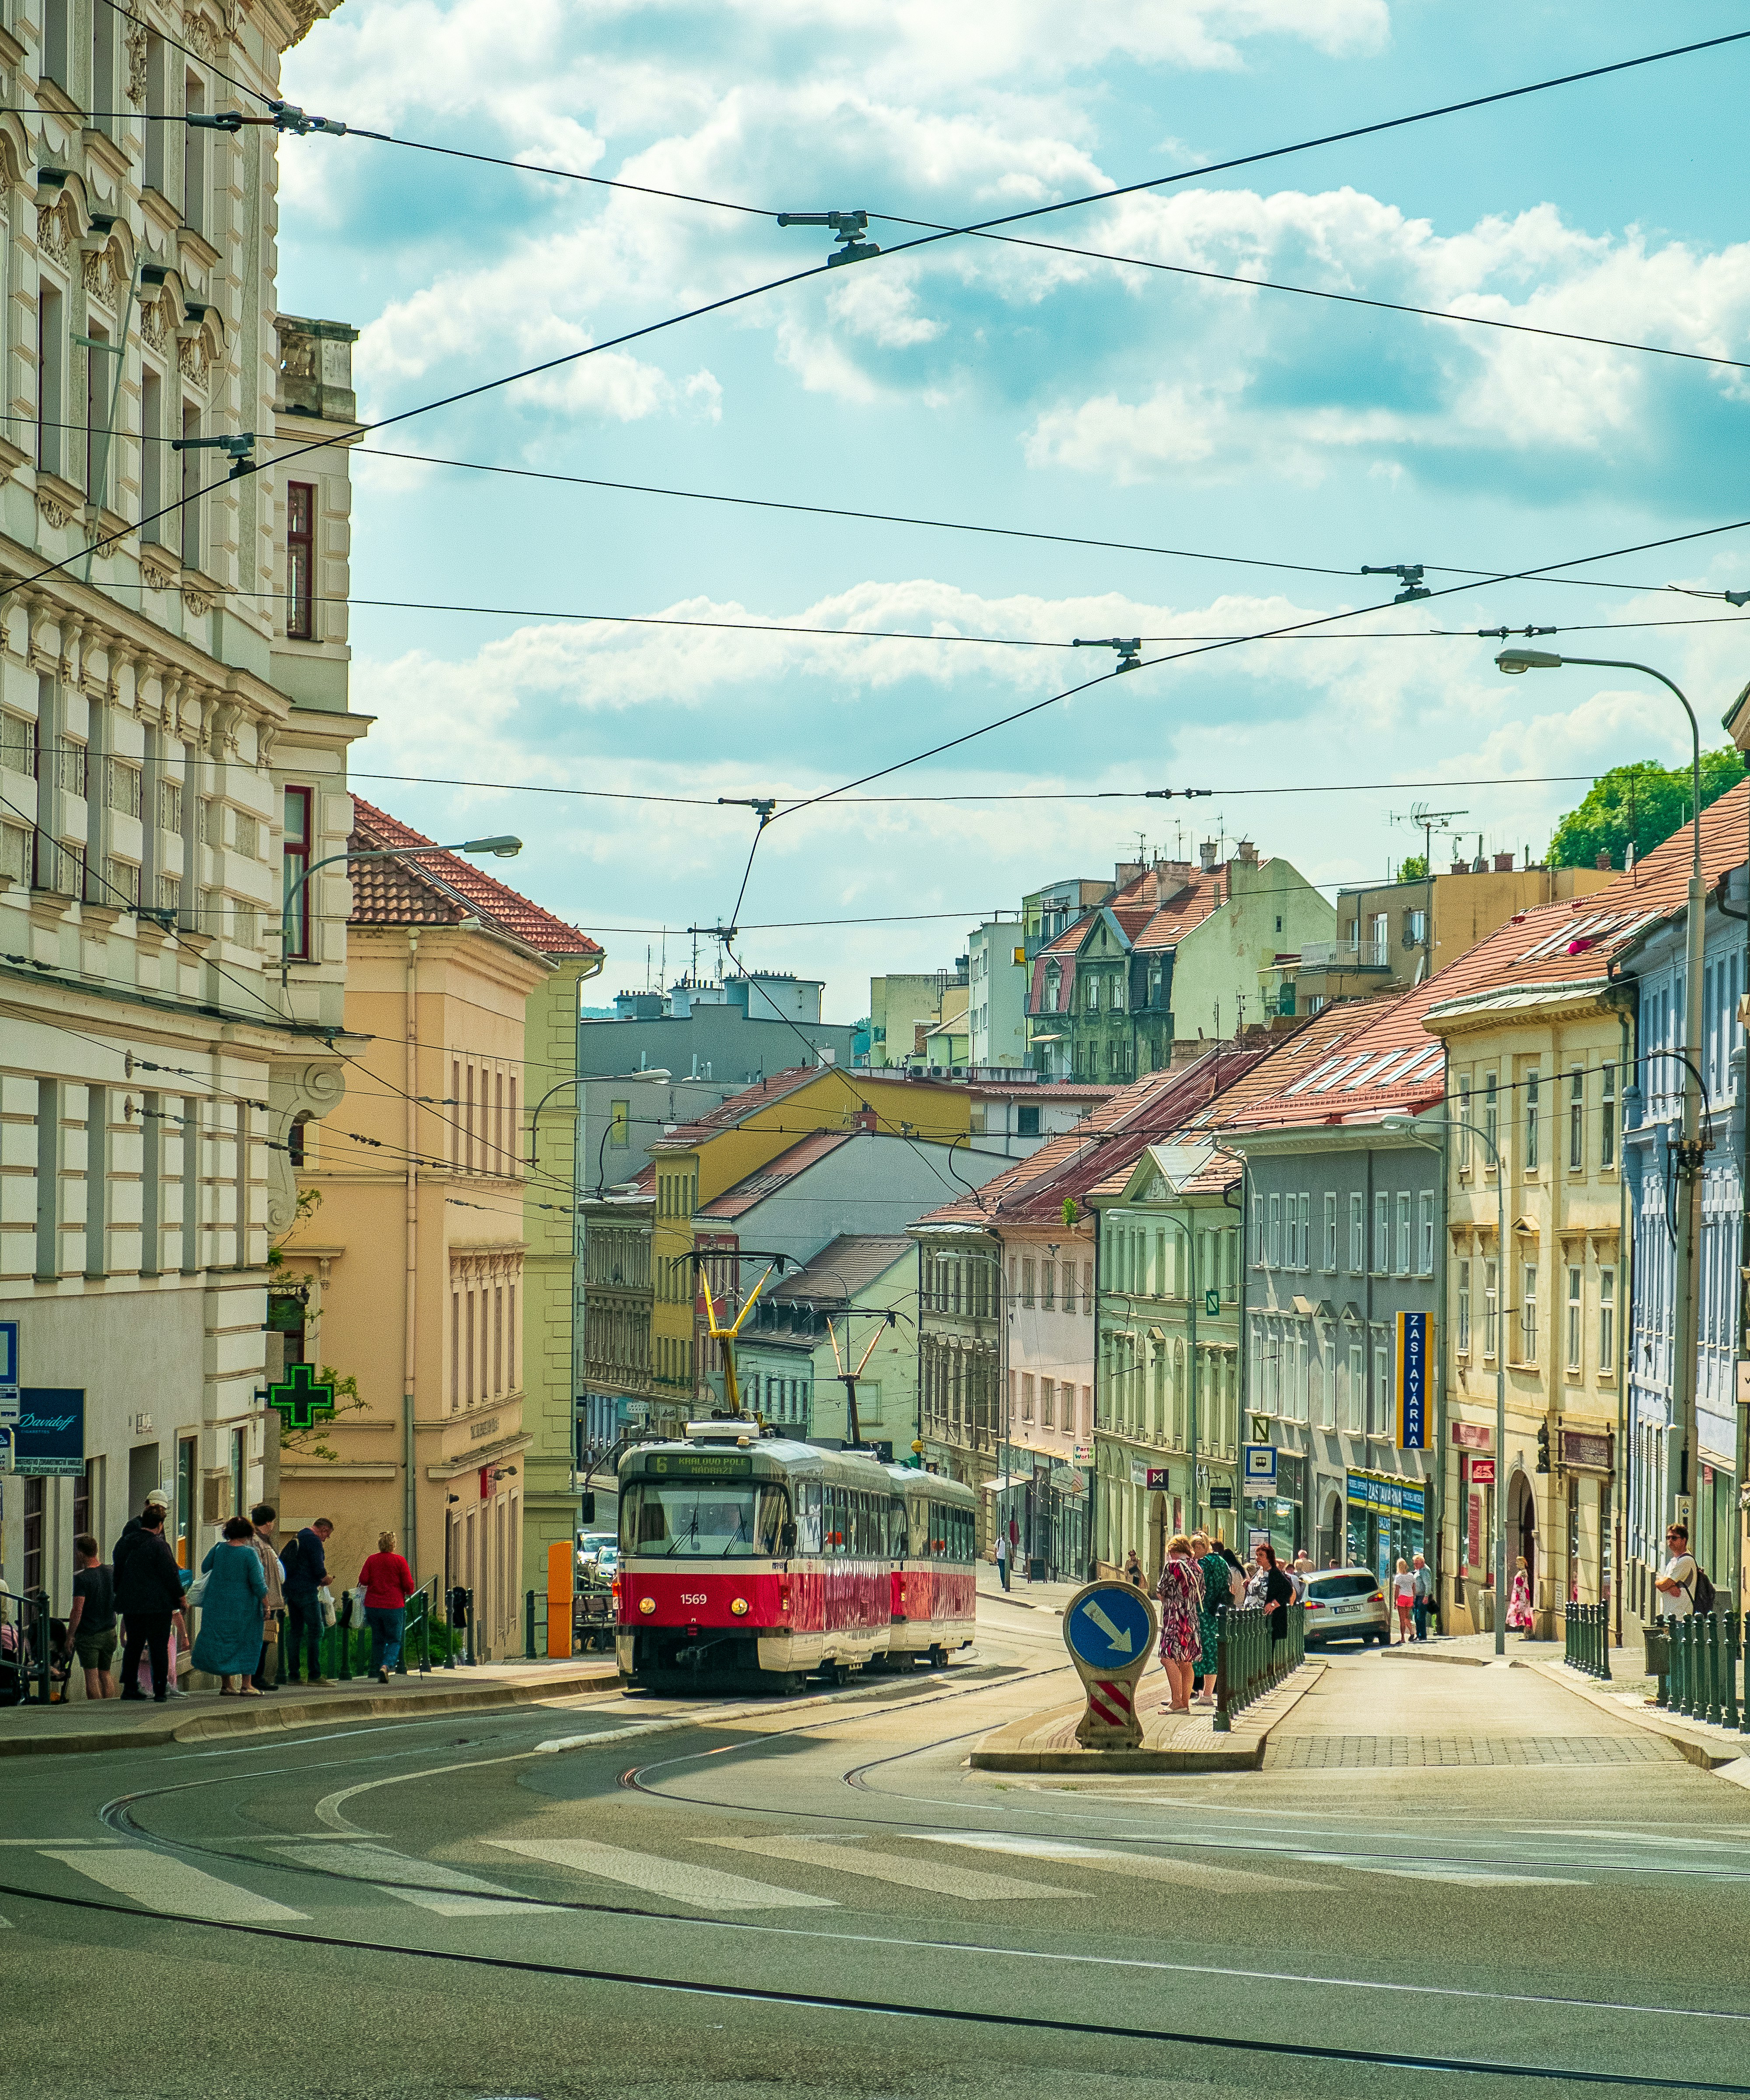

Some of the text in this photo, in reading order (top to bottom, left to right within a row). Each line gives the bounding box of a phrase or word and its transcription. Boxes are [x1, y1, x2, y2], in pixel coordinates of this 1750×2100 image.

[1409, 1315, 1420, 1446] ZASTAVÁRNA
[19, 1413, 77, 1431] Davidoff
[657, 1456, 667, 1473] 6
[680, 1594, 707, 1605] 1569
